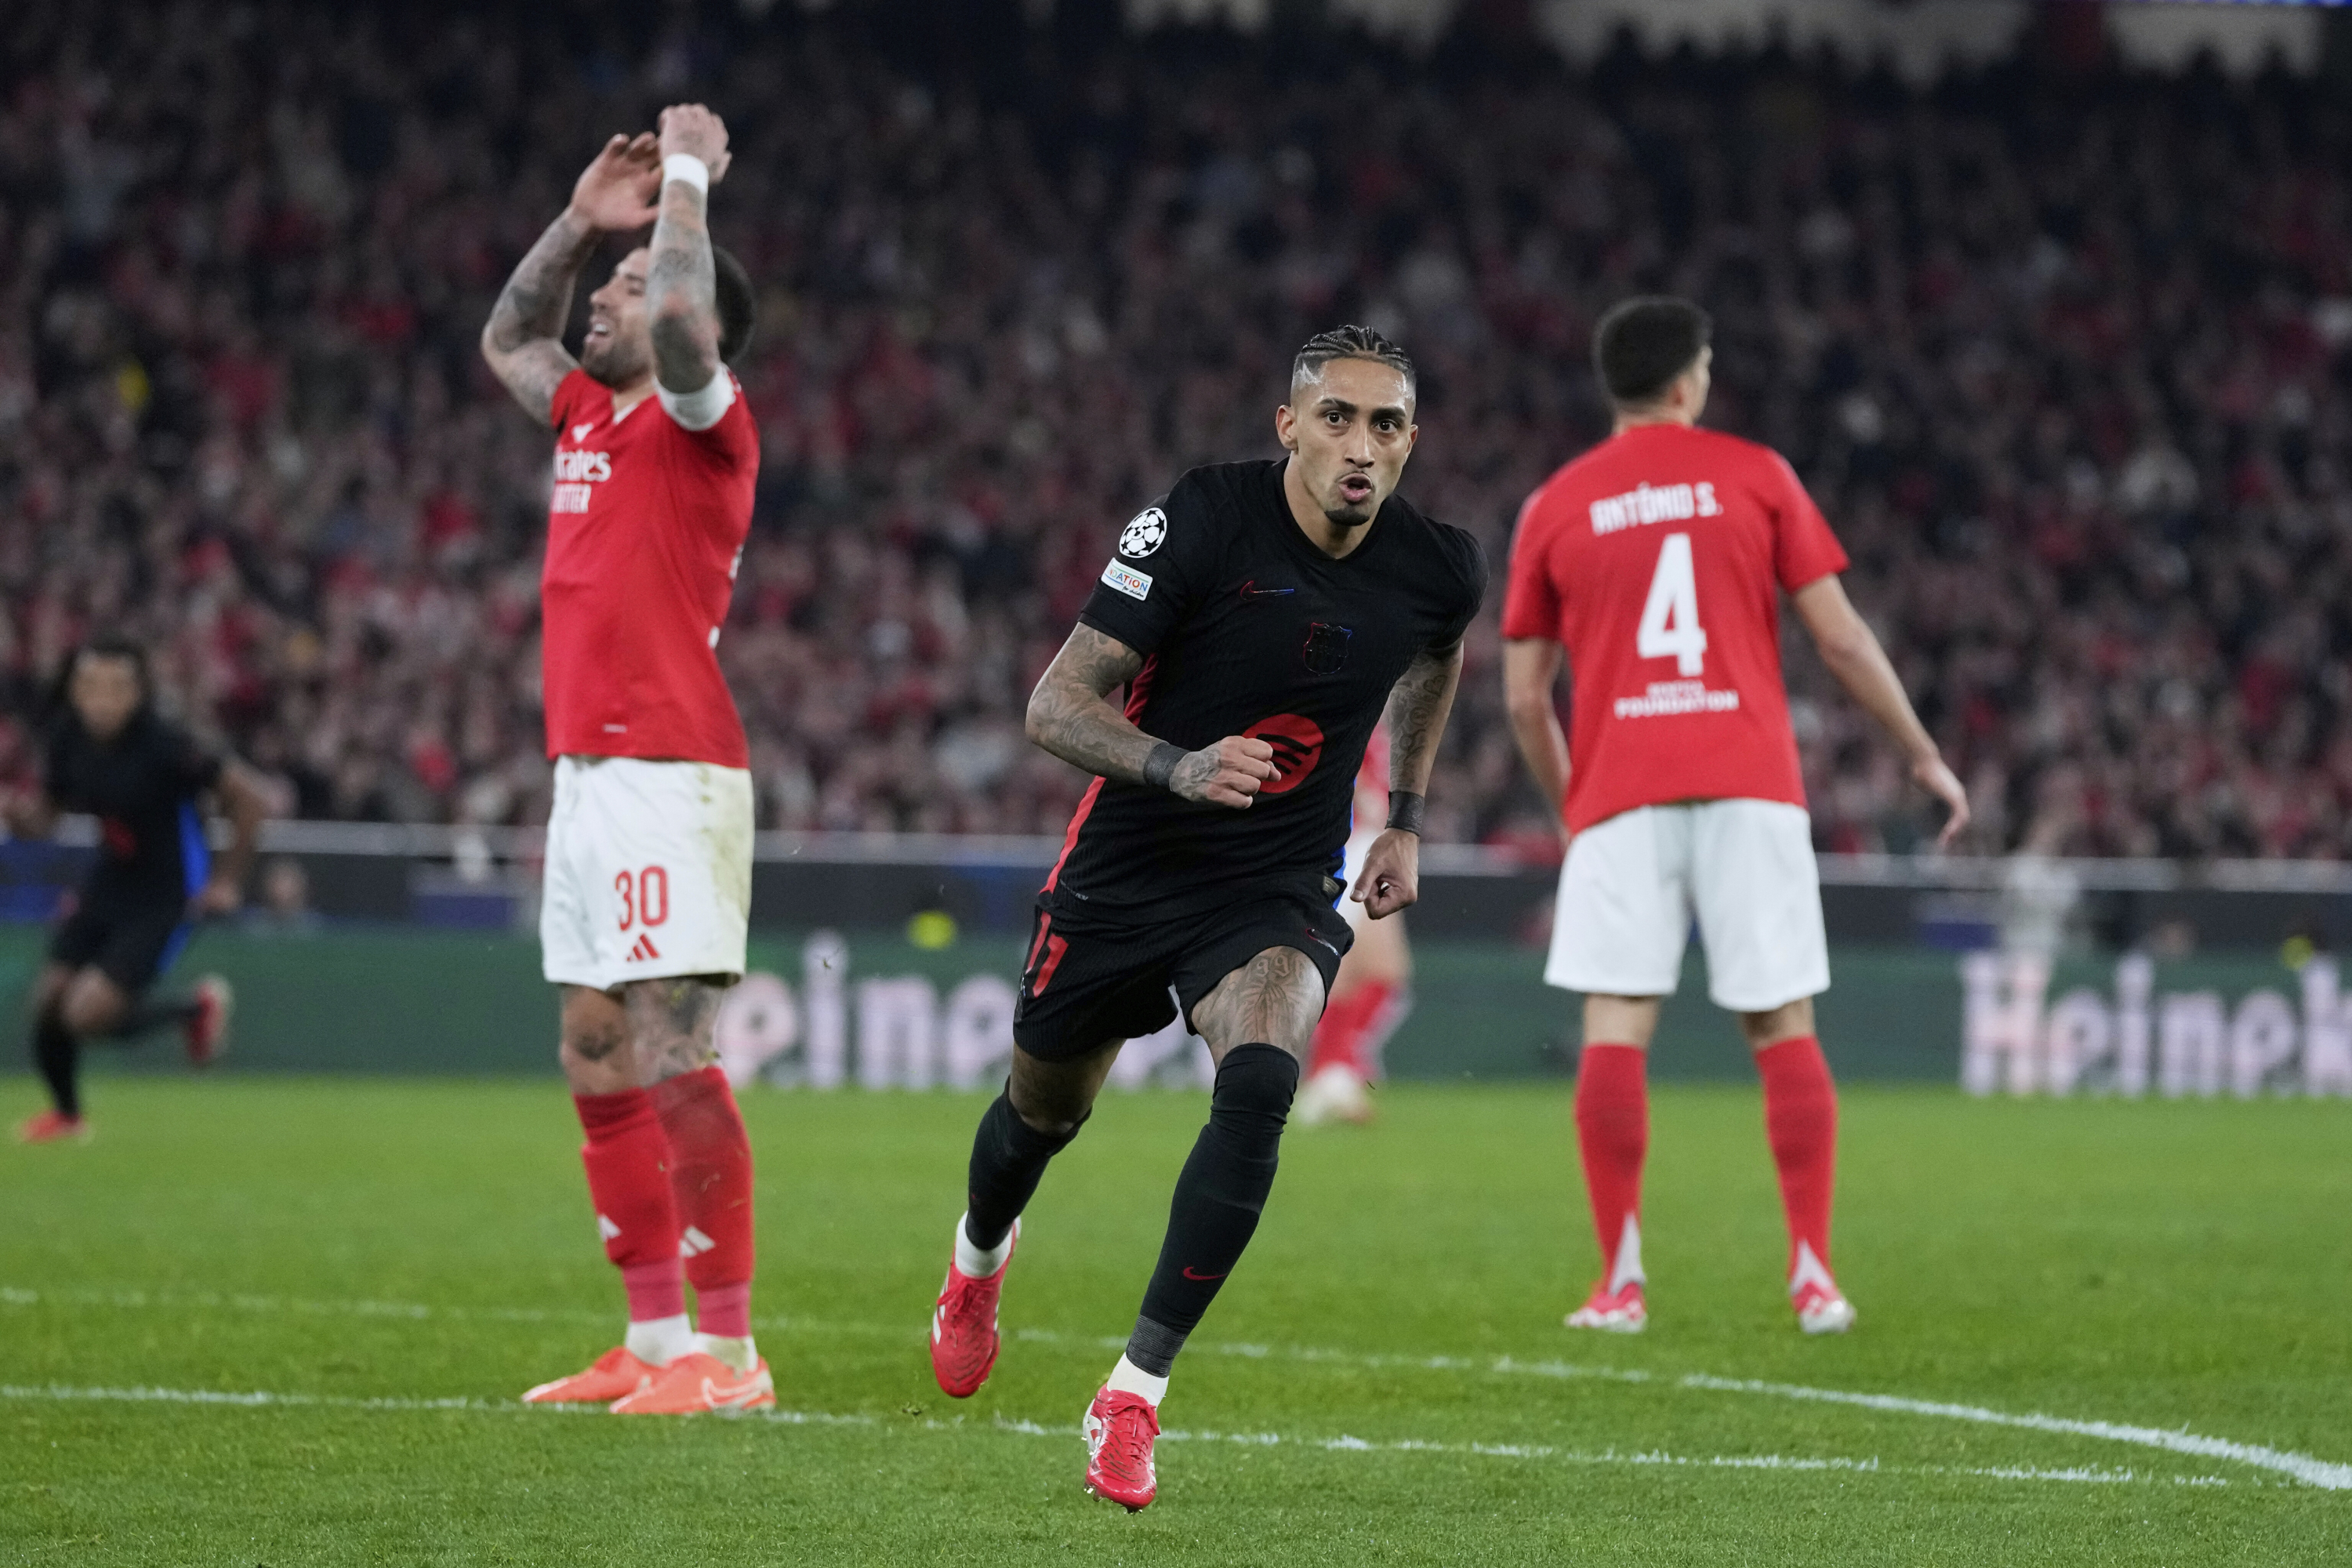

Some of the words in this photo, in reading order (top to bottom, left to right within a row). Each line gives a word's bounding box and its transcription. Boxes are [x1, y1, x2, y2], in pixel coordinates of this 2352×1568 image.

[1694, 481, 1724, 517] S.
[1636, 532, 1708, 677] 4
[1613, 688, 1740, 720] FOUNDATION
[615, 865, 670, 931] 30
